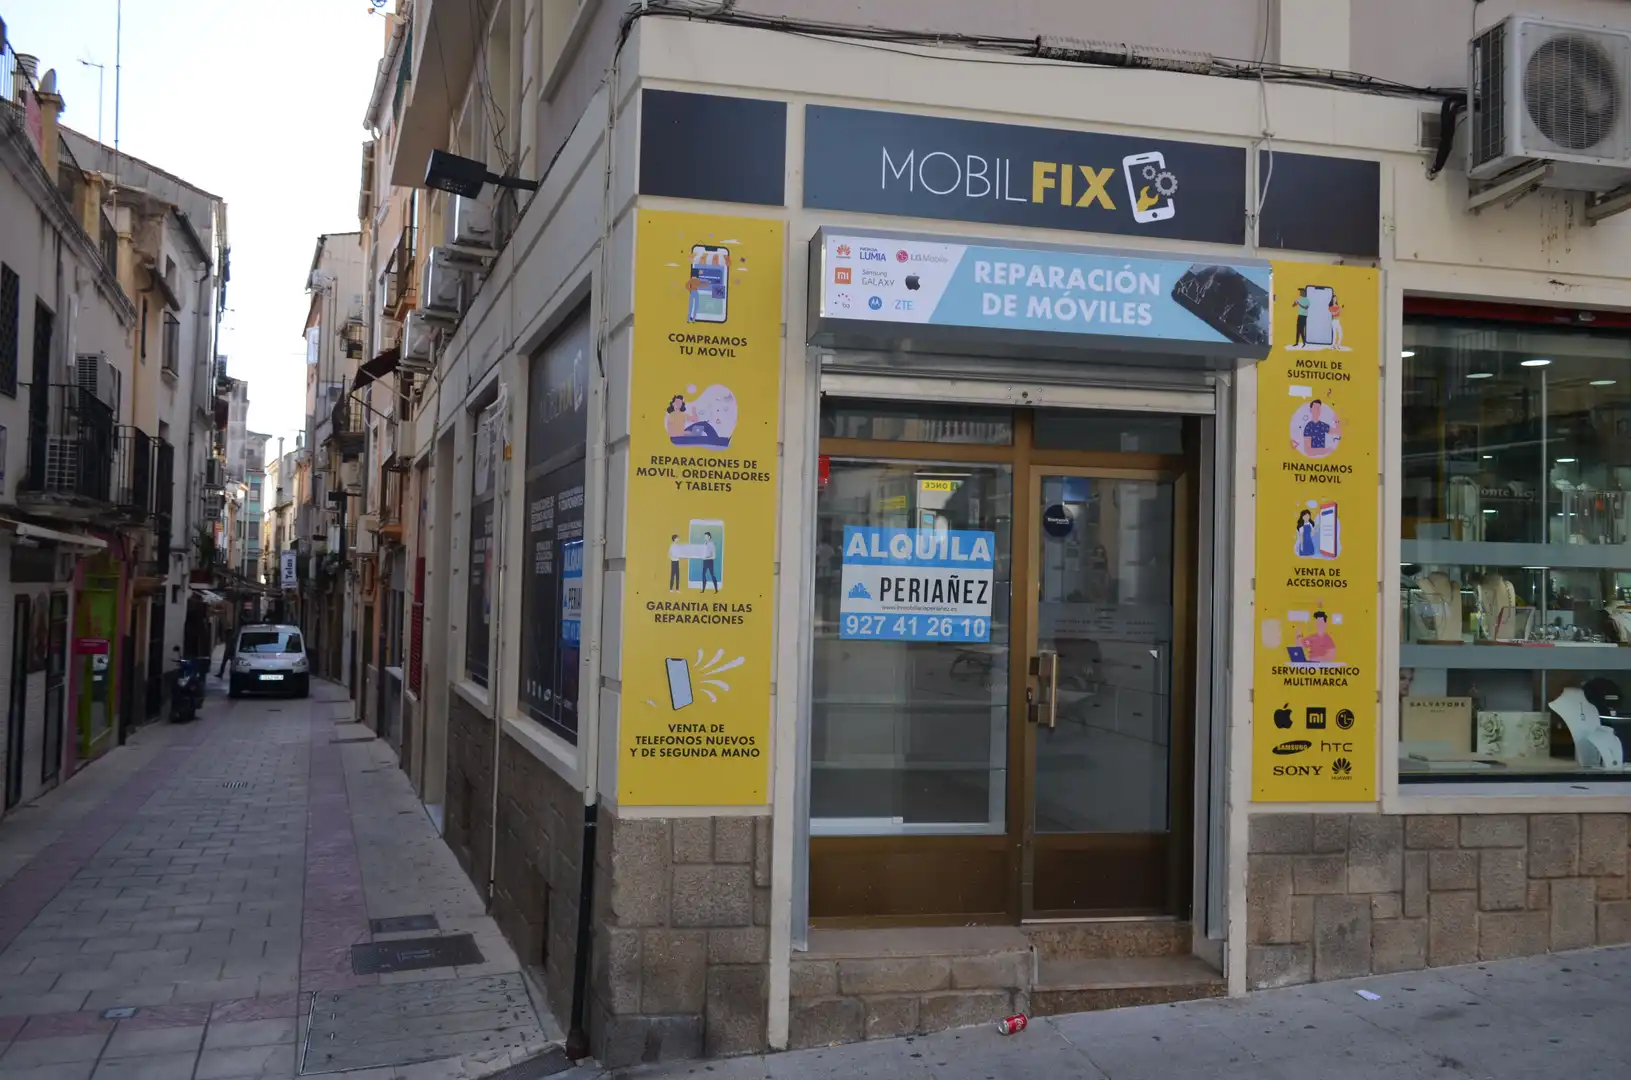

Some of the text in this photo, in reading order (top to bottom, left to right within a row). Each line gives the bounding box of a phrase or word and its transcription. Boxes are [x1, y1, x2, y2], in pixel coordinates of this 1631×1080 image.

[882, 146, 1117, 211] MOBIL FIX
[860, 252, 887, 261] LUMIA
[862, 269, 888, 278] Samsung
[974, 261, 1161, 296] REPARACIÓN
[861, 277, 895, 287] GALAXY
[895, 299, 913, 310] ZTE
[982, 291, 1153, 326] DE MÓVILES
[668, 333, 748, 347] COMPRAMOS
[680, 346, 736, 358] TU MOVIL
[1295, 359, 1342, 370] MOVIL DE
[1287, 369, 1351, 381] SUSTITUCION
[651, 455, 757, 469] REPARACIONES DE
[1282, 462, 1353, 474] FINANCIAMOS
[682, 469, 770, 481] ORDENADORES
[1294, 473, 1341, 484] TU MOVIL
[675, 481, 732, 492] Y TABLETS
[846, 532, 991, 562] ALQUILA
[285, 558, 293, 580] Telas
[1294, 567, 1340, 577] VENTA DE
[1286, 578, 1348, 588] ACCESORIOS
[879, 575, 989, 604] PERIAÑEZ
[646, 601, 752, 613] GARANTIA EN LAS
[654, 614, 744, 625] REPARACIONES
[846, 615, 986, 638] 927 41 26 10
[1271, 666, 1360, 676] SERVICIO TECNICO
[1283, 677, 1348, 687] MULTIMARCA
[668, 724, 725, 733] VENTA DE
[636, 735, 755, 745] TELEFONOS NUEVOS
[630, 748, 760, 757] Y DE SEGUNDA MANO
[1273, 765, 1323, 776] SONY
